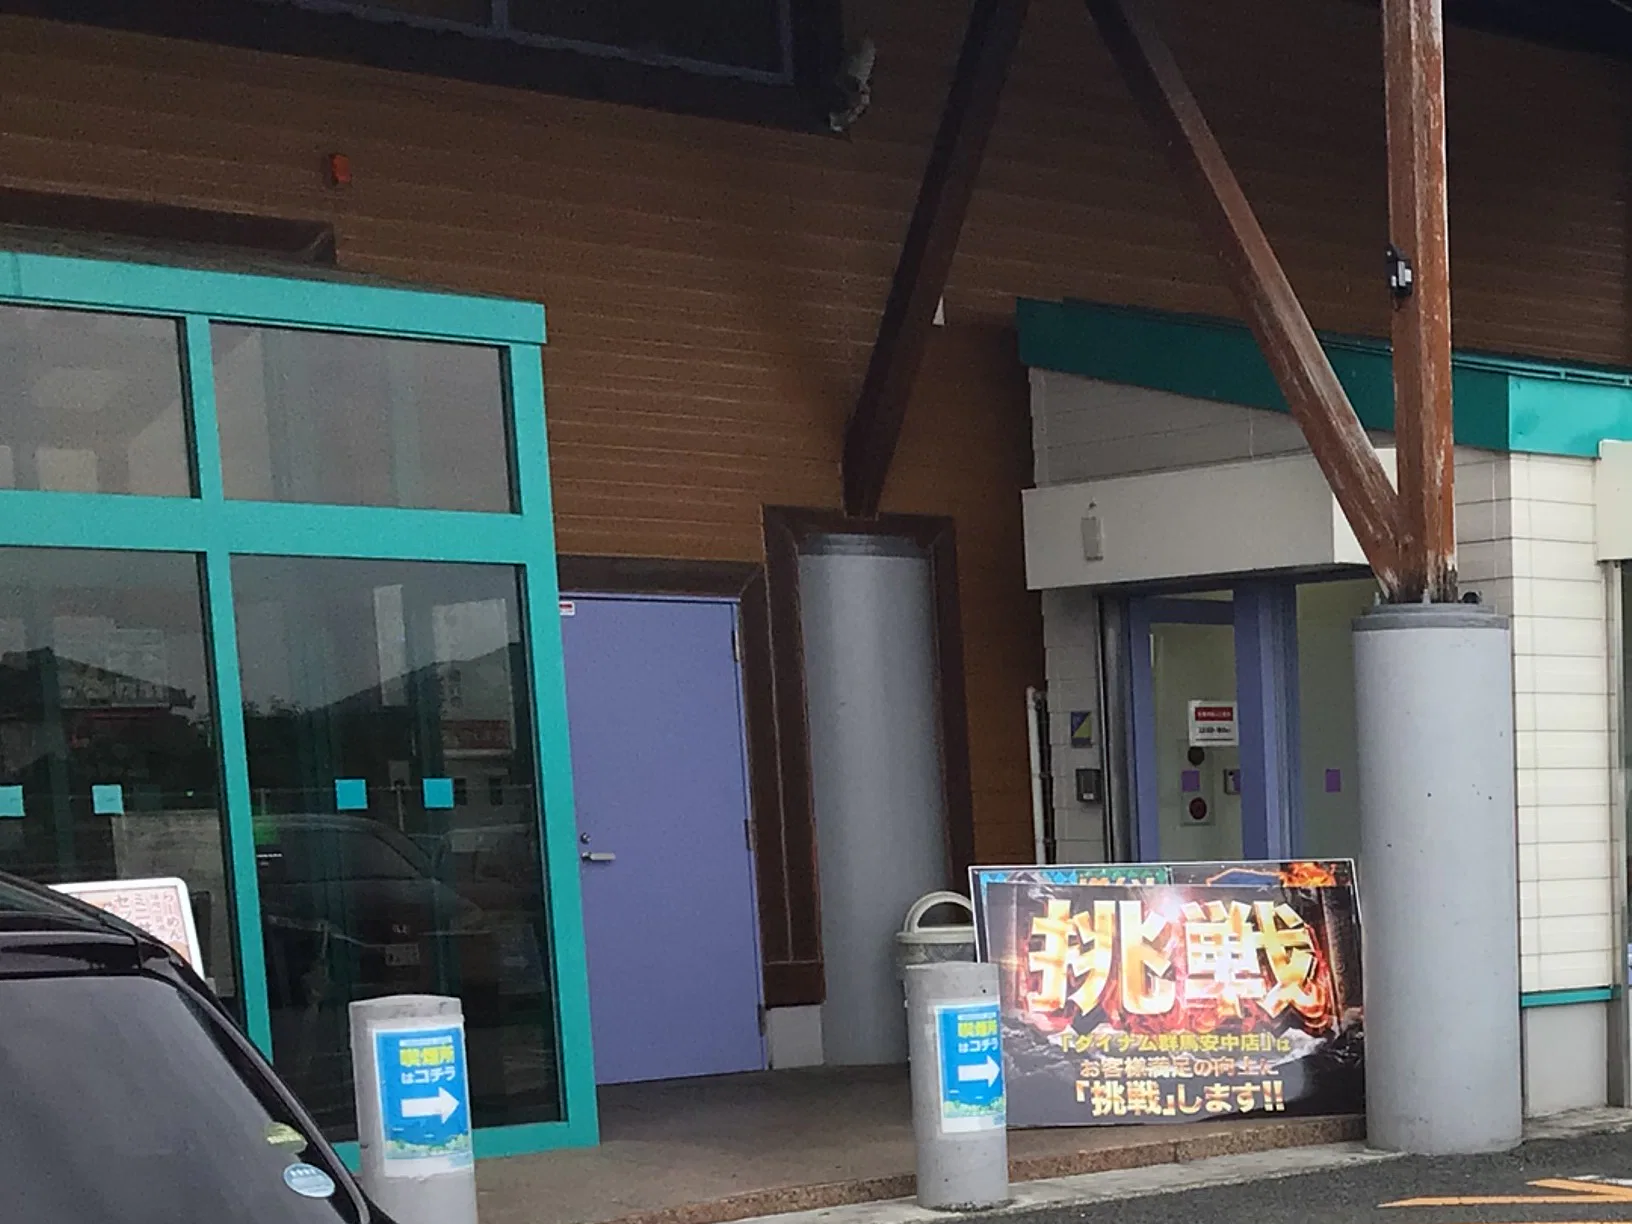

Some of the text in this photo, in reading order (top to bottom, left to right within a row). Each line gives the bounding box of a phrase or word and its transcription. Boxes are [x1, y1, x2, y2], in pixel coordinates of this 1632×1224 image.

[1027, 898, 1320, 1018] 挑戦
[957, 1036, 999, 1054] はコチラ
[400, 1066, 457, 1085] はコチラ
[1079, 1055, 1279, 1079] お客様満足の向上に
